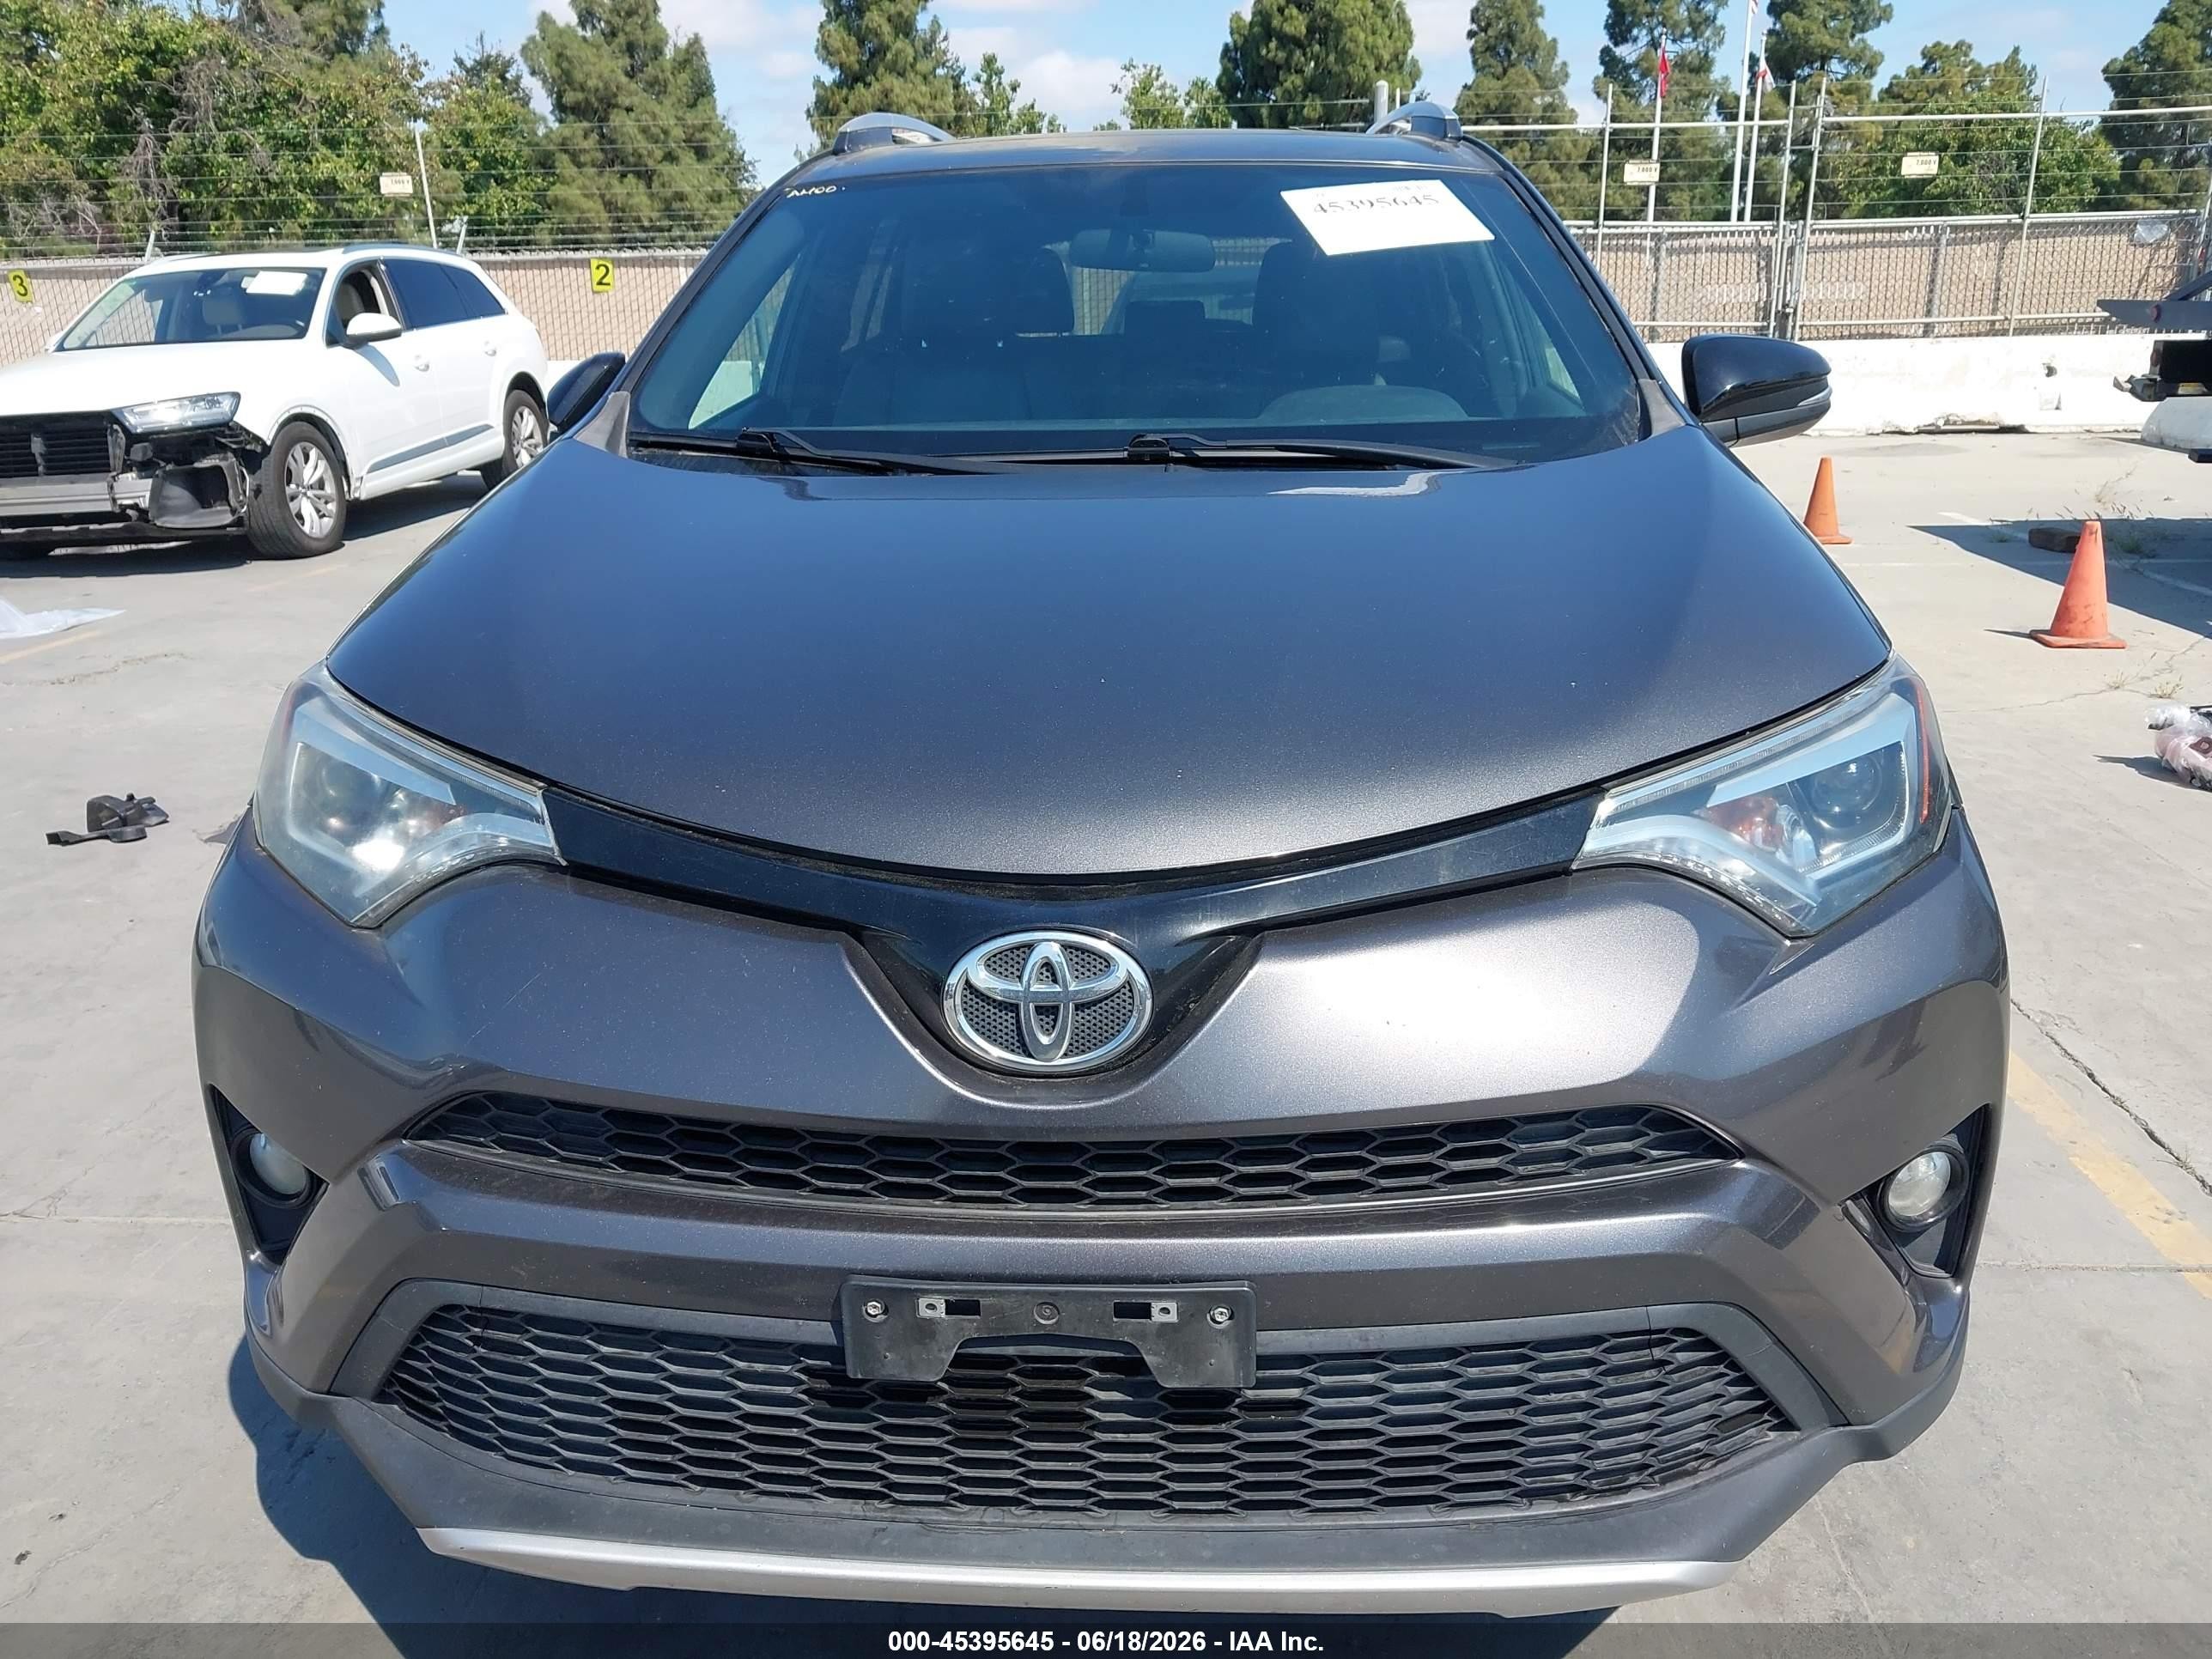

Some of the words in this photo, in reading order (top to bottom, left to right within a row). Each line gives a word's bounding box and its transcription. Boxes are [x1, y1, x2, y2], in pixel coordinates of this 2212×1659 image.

[1314, 194, 1439, 214] 45395645
[13, 275, 28, 296] 3
[595, 264, 611, 286] 2
